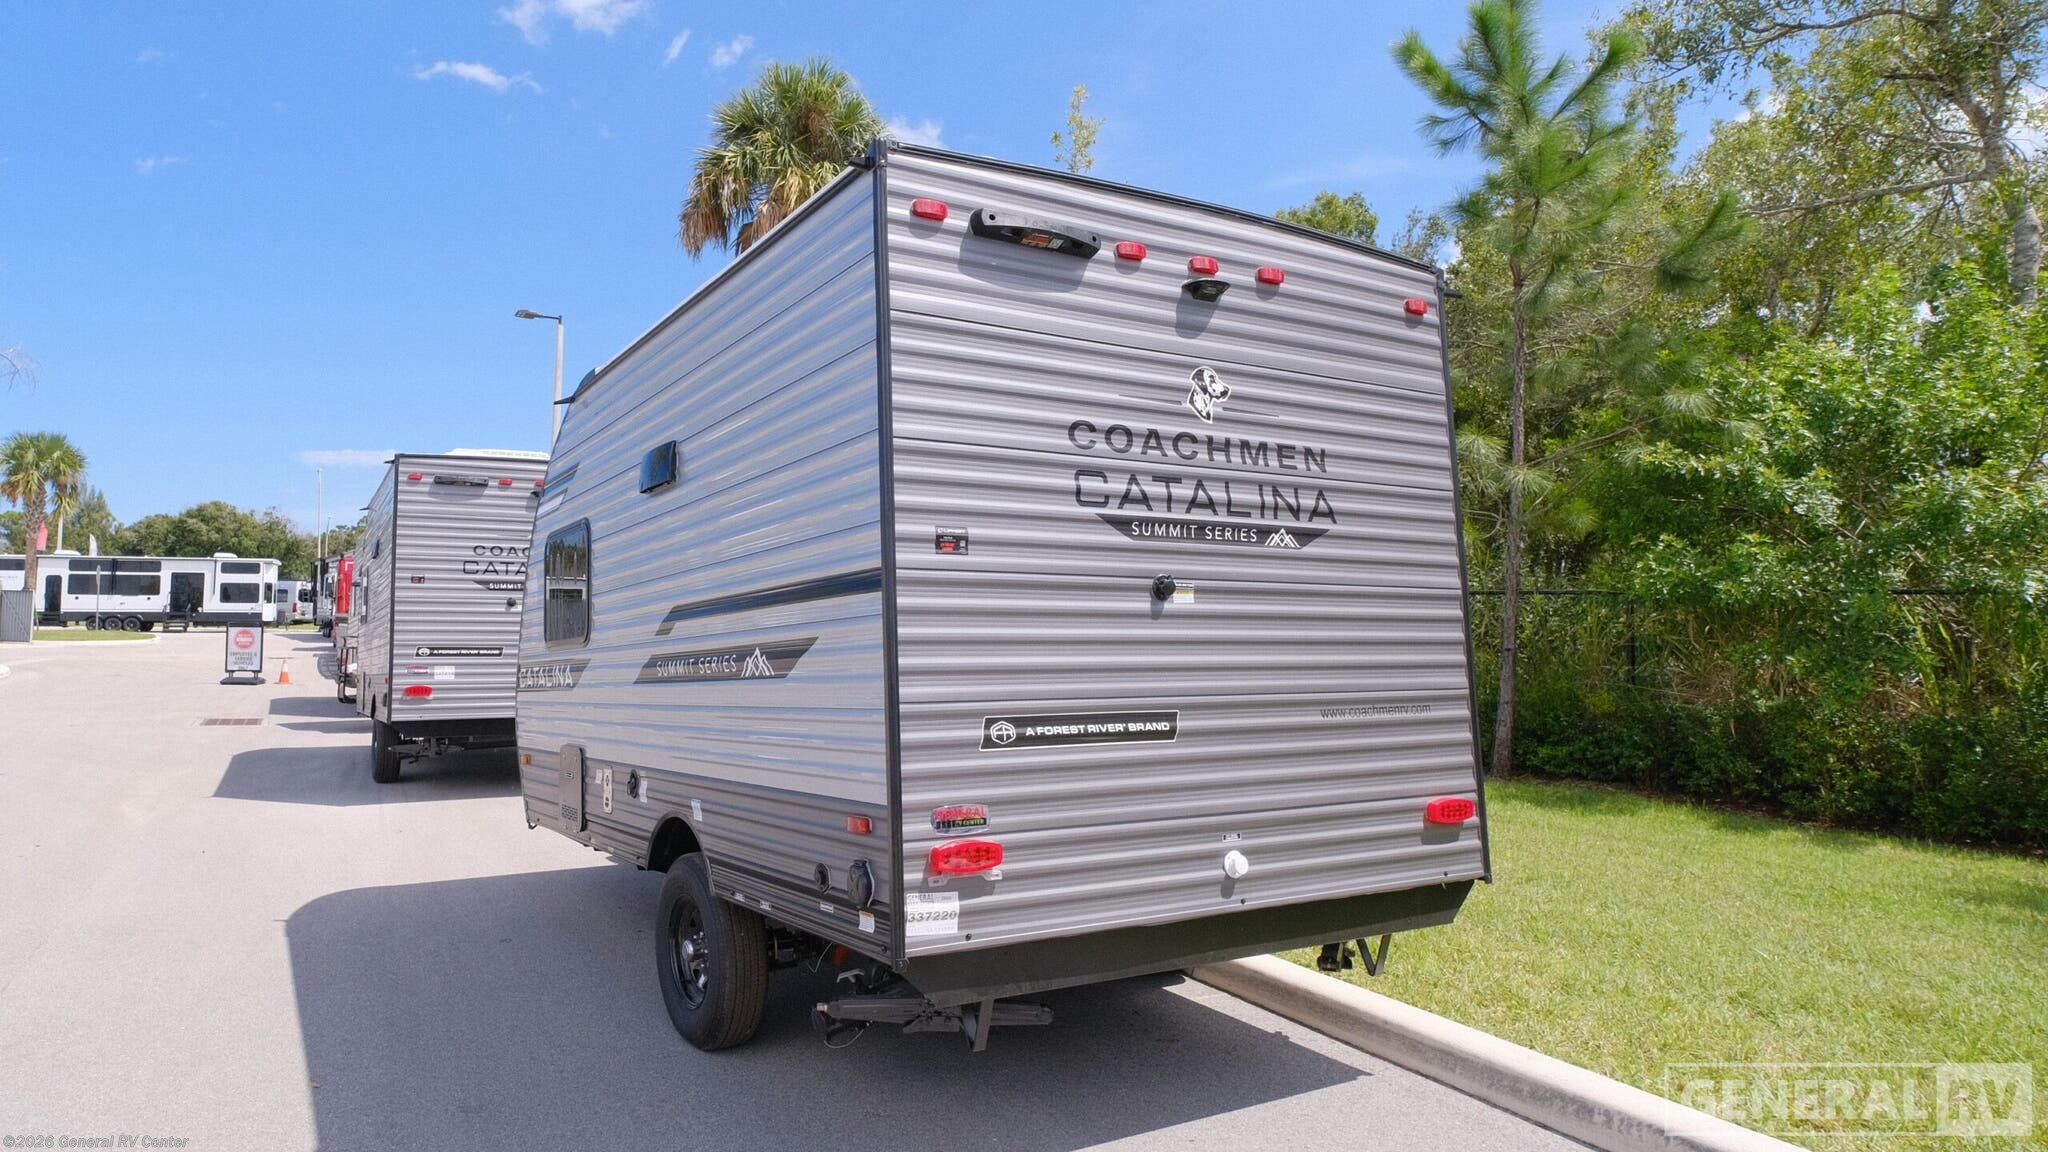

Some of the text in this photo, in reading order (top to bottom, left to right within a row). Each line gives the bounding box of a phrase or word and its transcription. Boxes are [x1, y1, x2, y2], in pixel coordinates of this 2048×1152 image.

[1067, 419, 1328, 473] COACHMEN
[1073, 469, 1338, 524] CATALINA
[1131, 521, 1257, 543] SUMMIT SERIES
[473, 545, 530, 557] COAC
[462, 560, 528, 575] CATA
[656, 654, 737, 677] SUMMIT SERIES
[519, 665, 573, 688] CATALINA
[1320, 704, 1431, 719] www.coachmenrv.com
[1025, 727, 1035, 736] A
[1036, 725, 1085, 735] FOREST
[1129, 722, 1170, 731] BRAND
[908, 910, 957, 922] 337220
